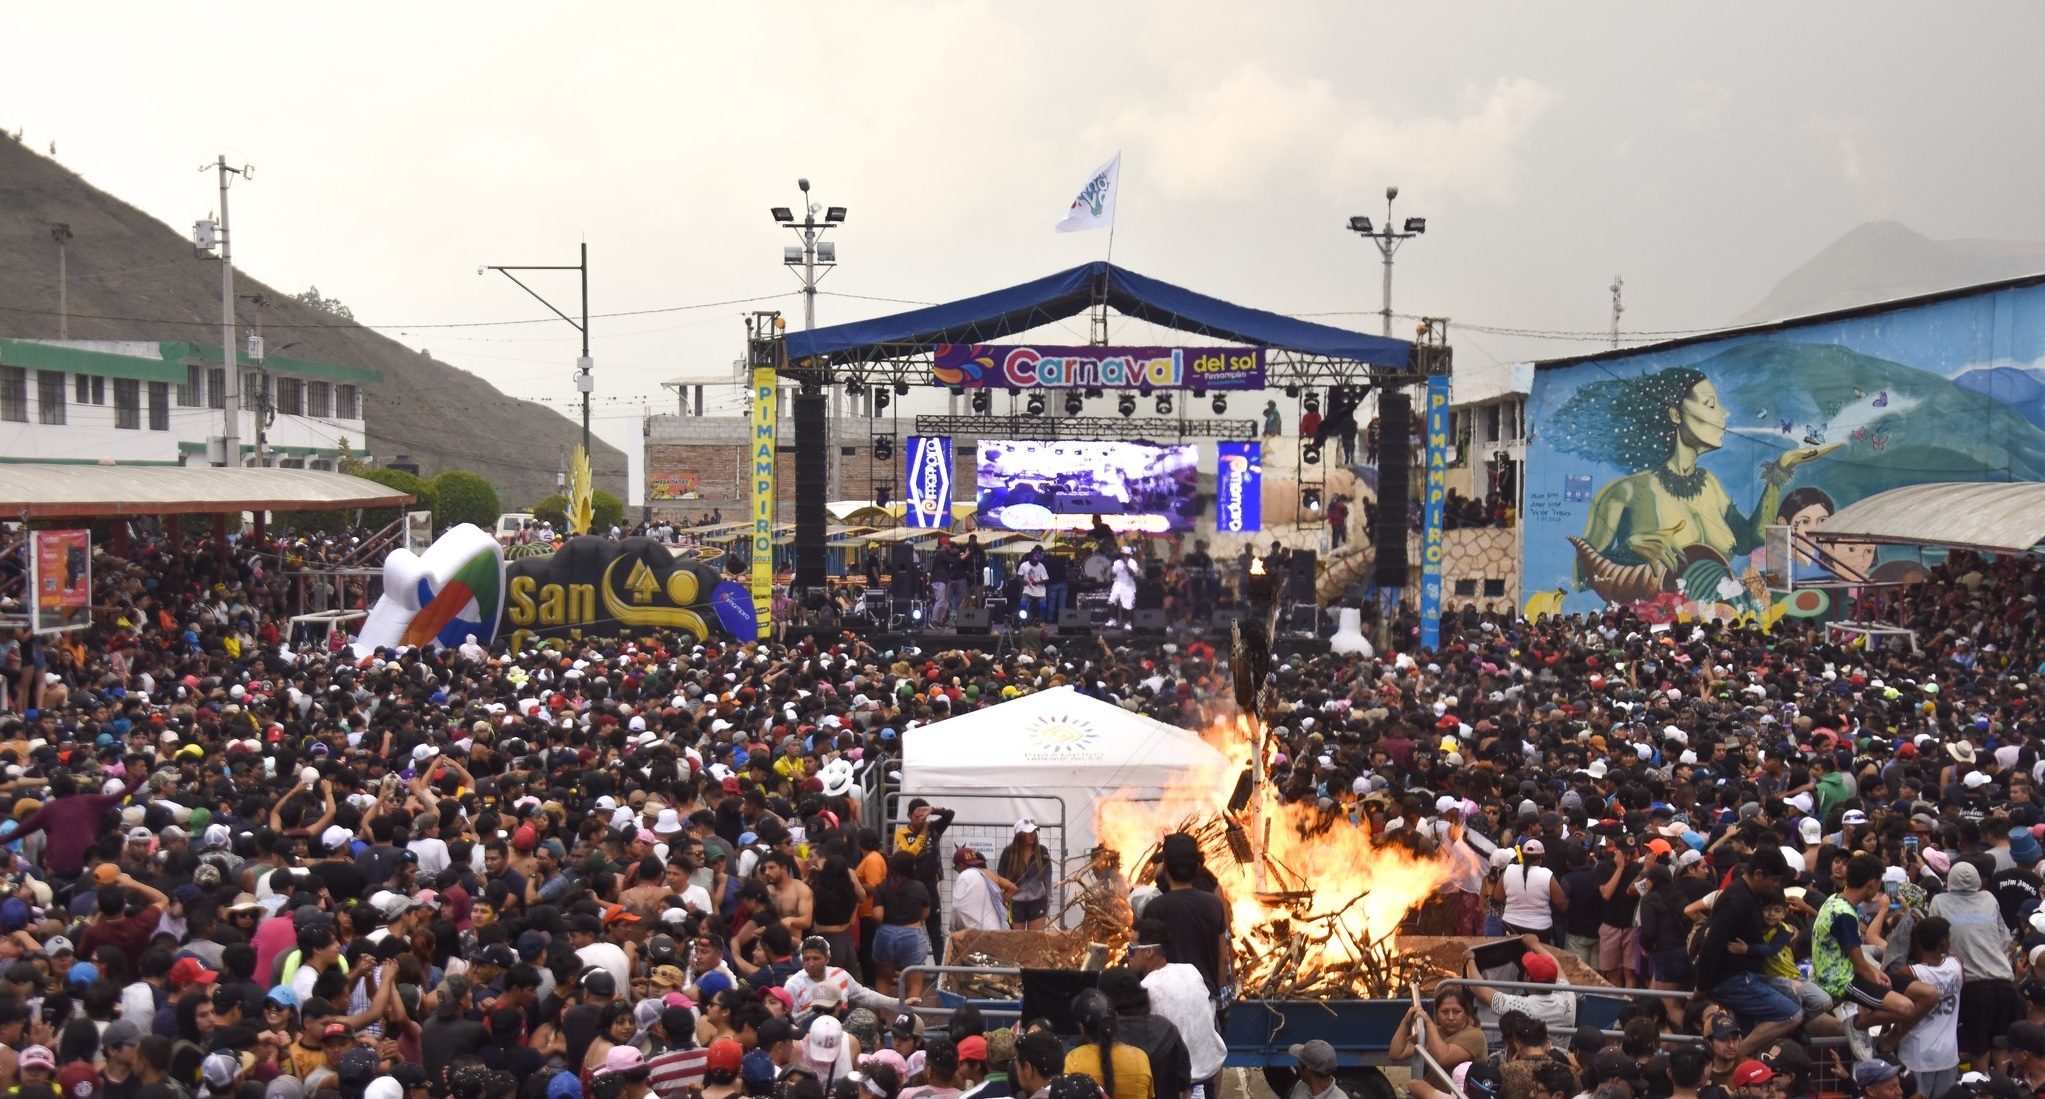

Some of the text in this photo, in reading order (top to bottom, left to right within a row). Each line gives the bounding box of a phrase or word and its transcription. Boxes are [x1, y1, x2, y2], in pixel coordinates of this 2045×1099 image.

[1004, 347, 1183, 387] Carnaval
[1193, 351, 1257, 373] del sol
[756, 386, 772, 551] PIMAMPIRO
[1426, 394, 1446, 562] PIMAMPIRO
[508, 575, 596, 626] San
